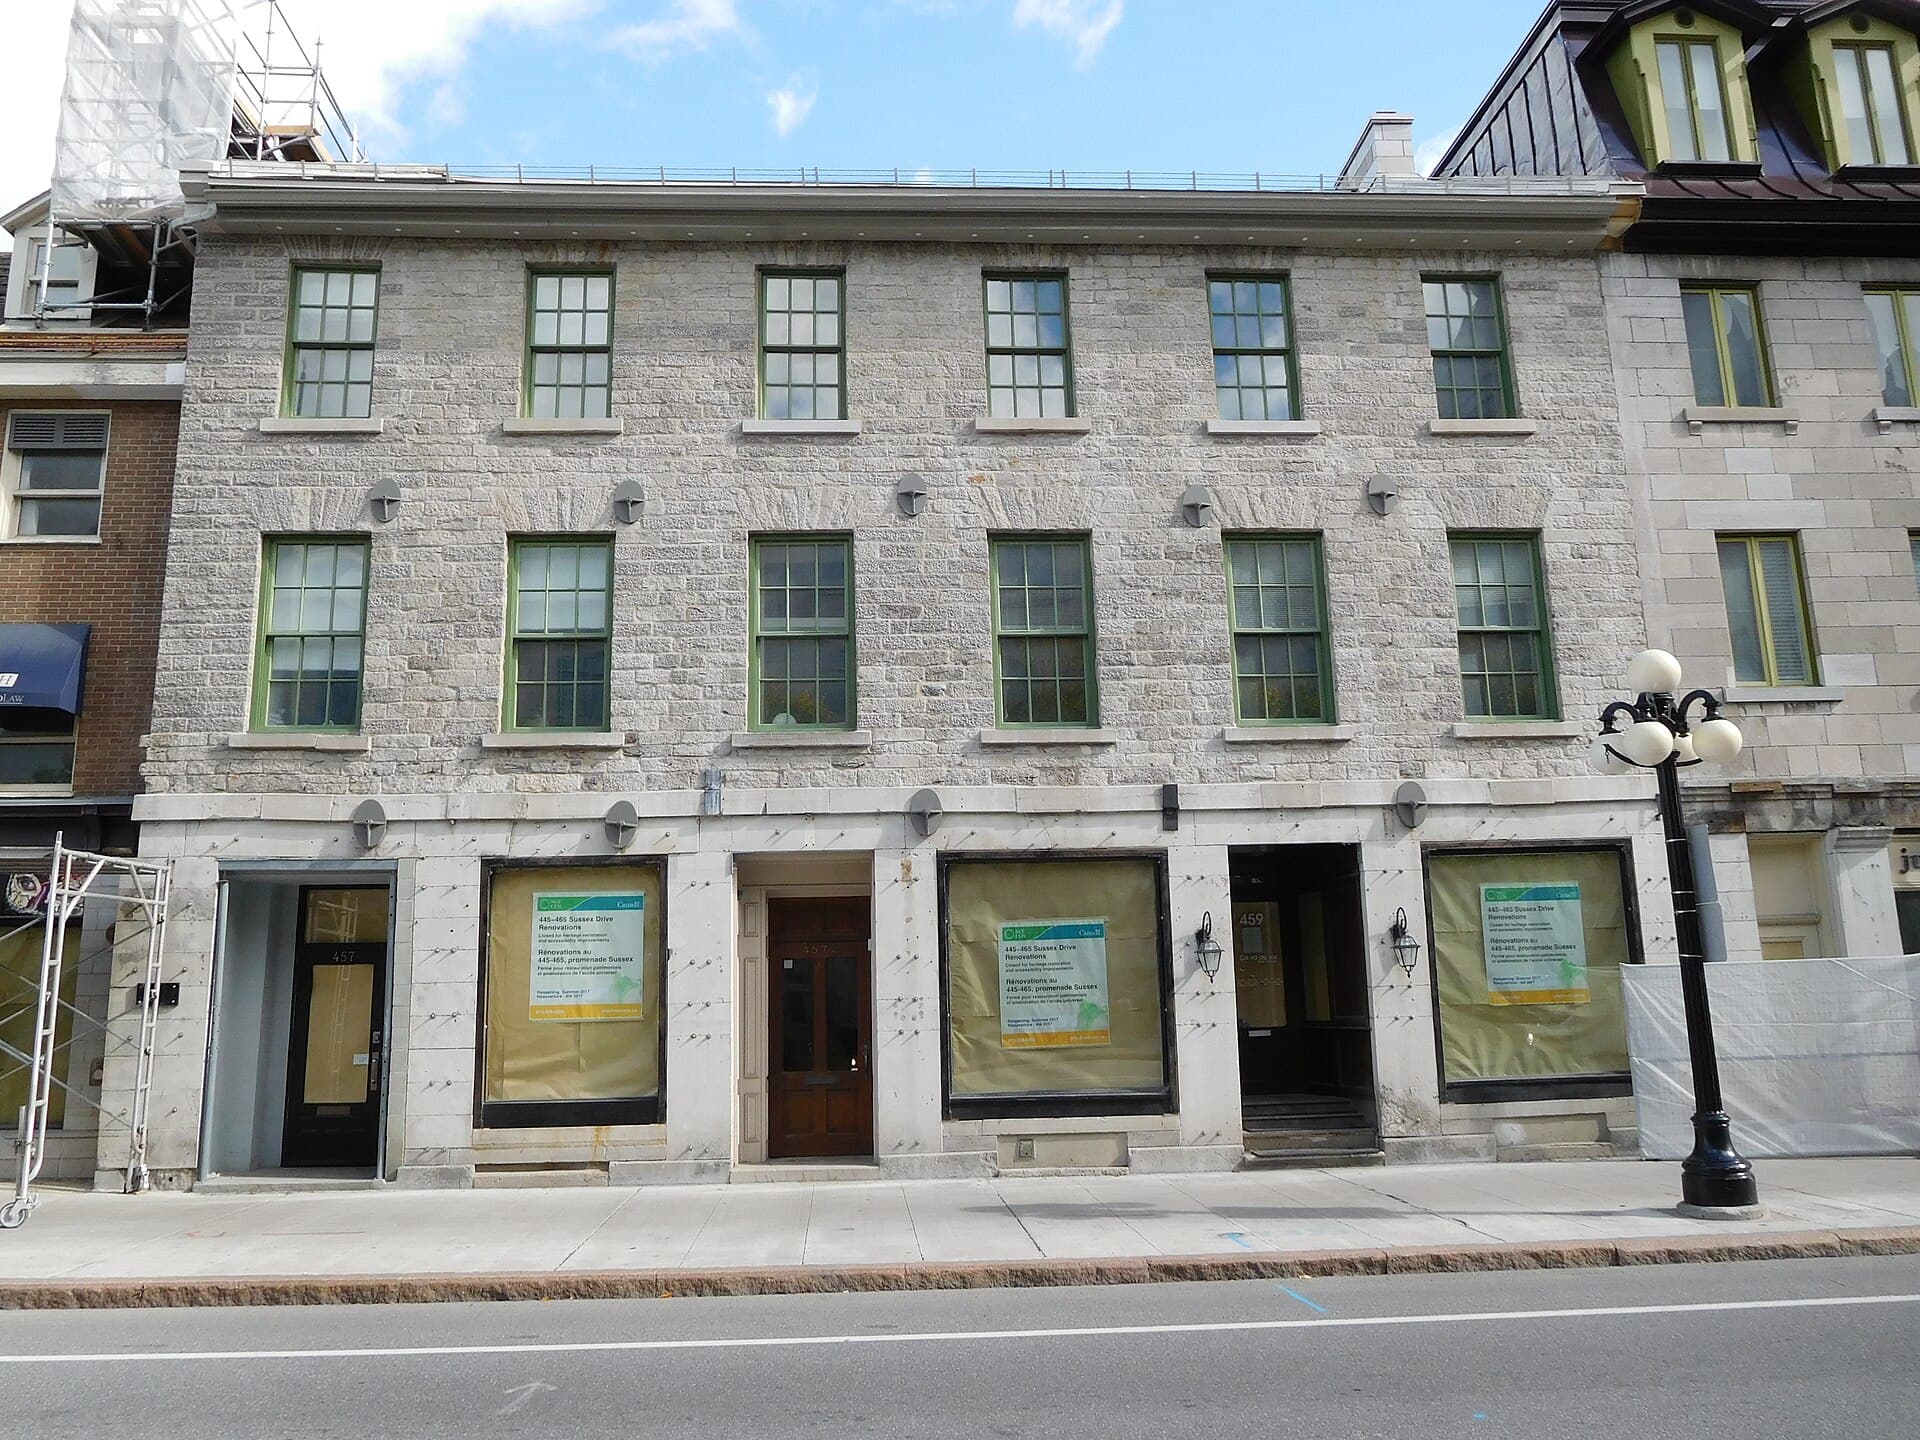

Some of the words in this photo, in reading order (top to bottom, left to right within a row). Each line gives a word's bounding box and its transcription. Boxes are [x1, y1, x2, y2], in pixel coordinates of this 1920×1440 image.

[1240, 912, 1264, 926] 459
[332, 951, 355, 962] 457
[1036, 984, 1072, 992] promenade
